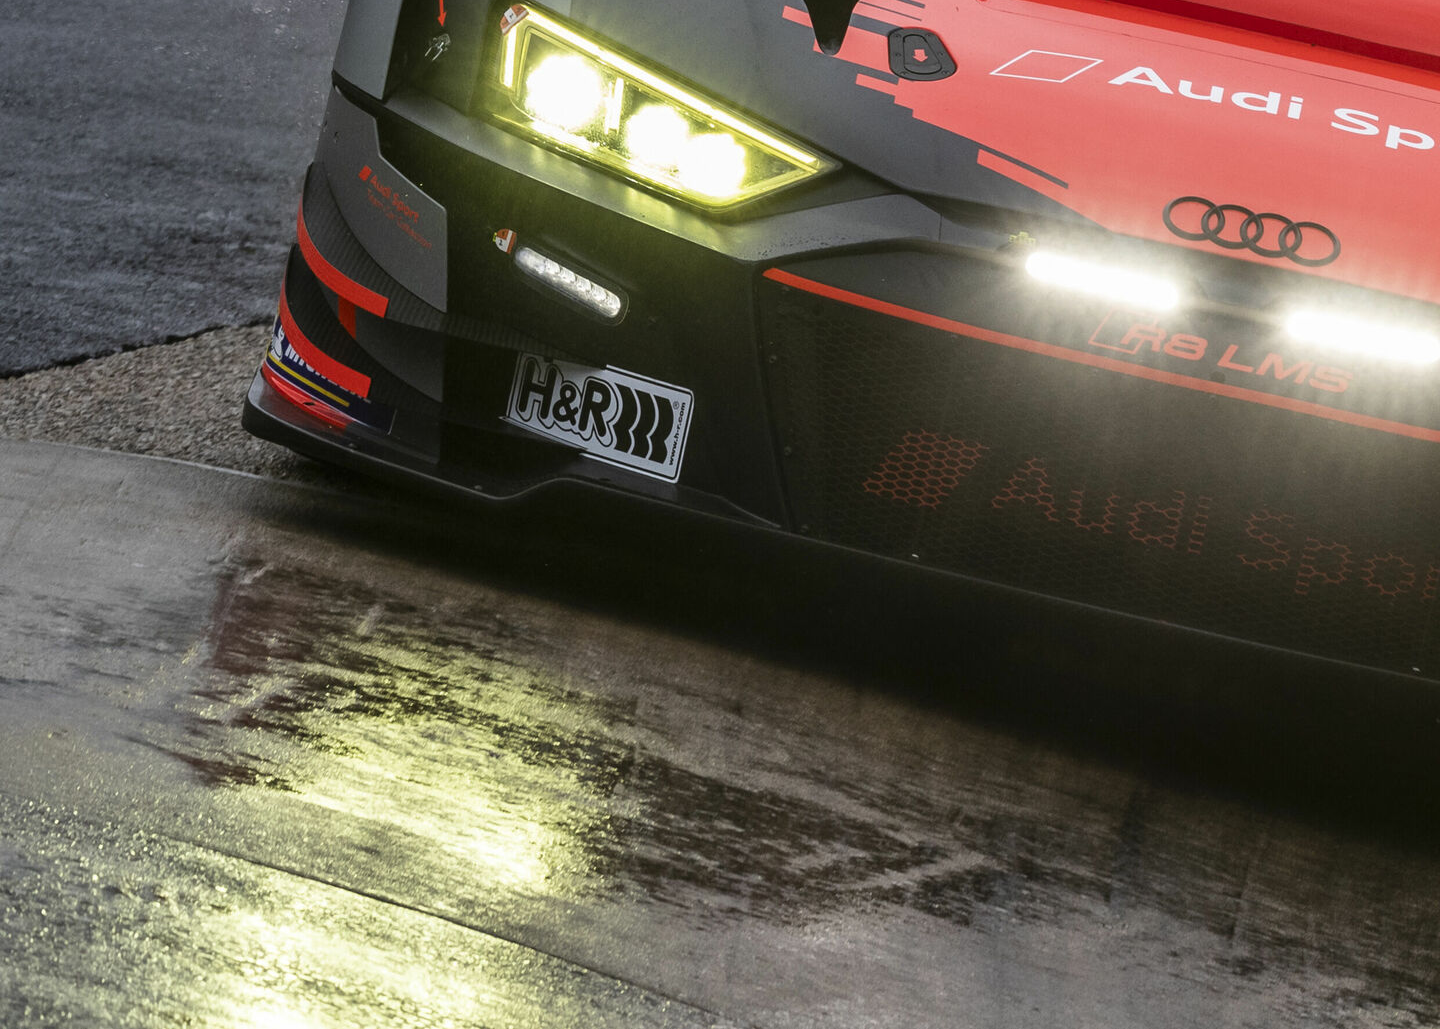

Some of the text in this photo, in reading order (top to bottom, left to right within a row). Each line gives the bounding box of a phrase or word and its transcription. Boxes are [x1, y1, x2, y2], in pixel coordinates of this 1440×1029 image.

[1107, 65, 1304, 120] Audi
[370, 174, 419, 225] Audi Sport
[1119, 323, 1355, 394] R8 LMS
[517, 361, 617, 447] H&R
[668, 401, 687, 466] www.h-r.com
[991, 457, 1213, 555] Audi
